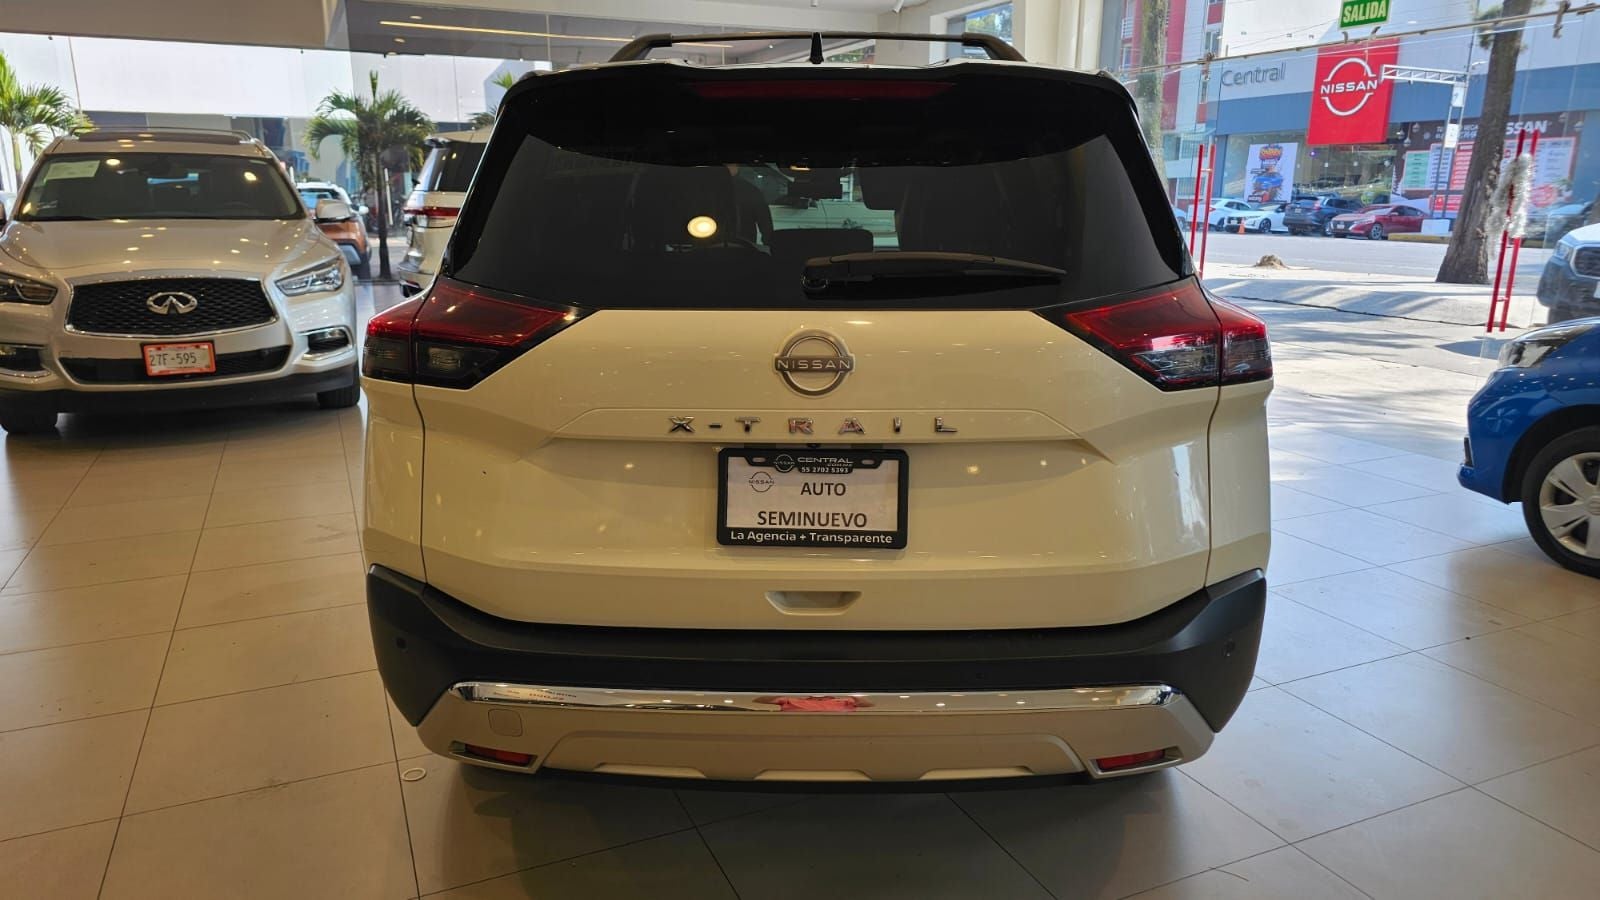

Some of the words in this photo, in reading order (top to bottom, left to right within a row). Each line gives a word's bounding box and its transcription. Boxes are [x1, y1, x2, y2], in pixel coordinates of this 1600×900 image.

[1343, 1, 1386, 24] SALIDA
[1221, 62, 1287, 87] Central
[1320, 80, 1378, 95] NISSAN
[777, 358, 851, 370] NISSAN
[668, 415, 958, 435] X-TRAIL
[800, 482, 846, 496] AUTO
[757, 511, 868, 528] SEMINUEVO
[730, 531, 744, 540] La
[747, 532, 796, 542] Agencia
[809, 533, 893, 545] Transparente
